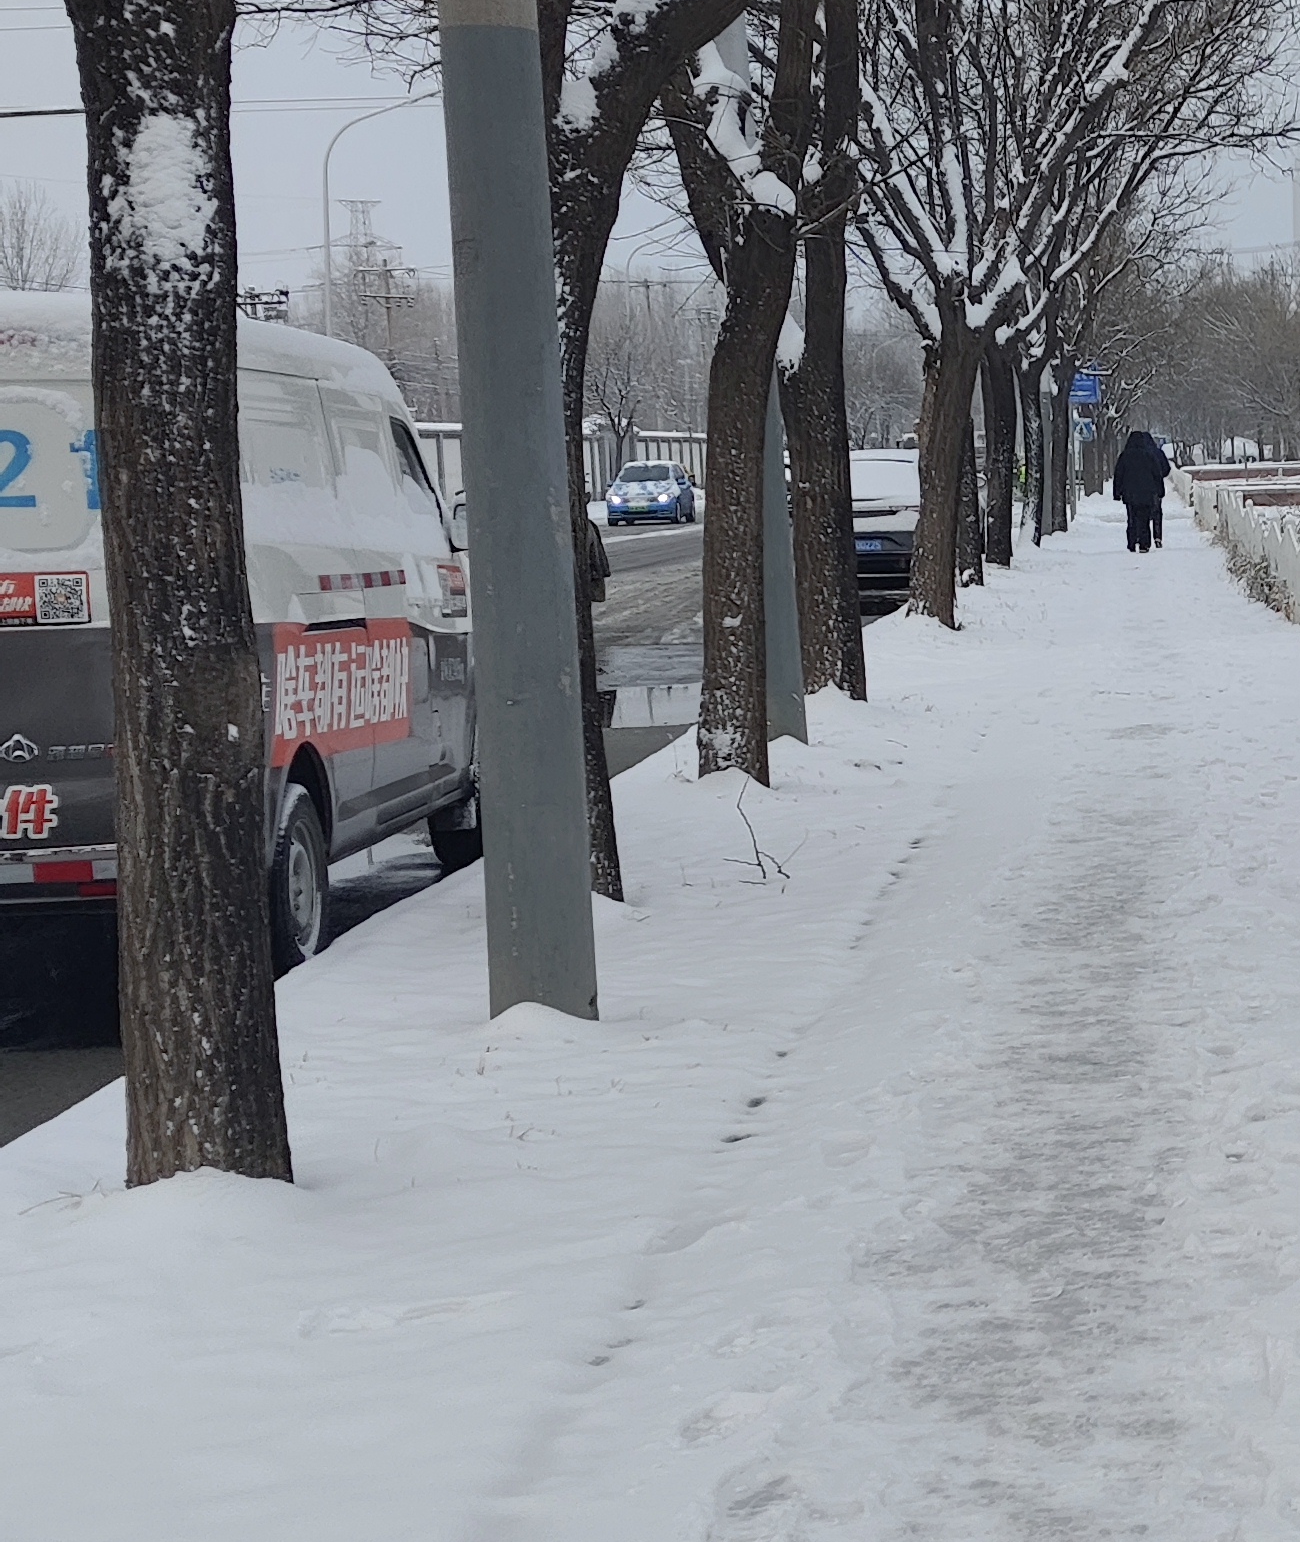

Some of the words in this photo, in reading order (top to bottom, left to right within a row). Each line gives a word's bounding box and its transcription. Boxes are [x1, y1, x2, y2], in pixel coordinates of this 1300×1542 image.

[274, 641, 349, 741] 啥车都有
[3, 787, 56, 837] 件
